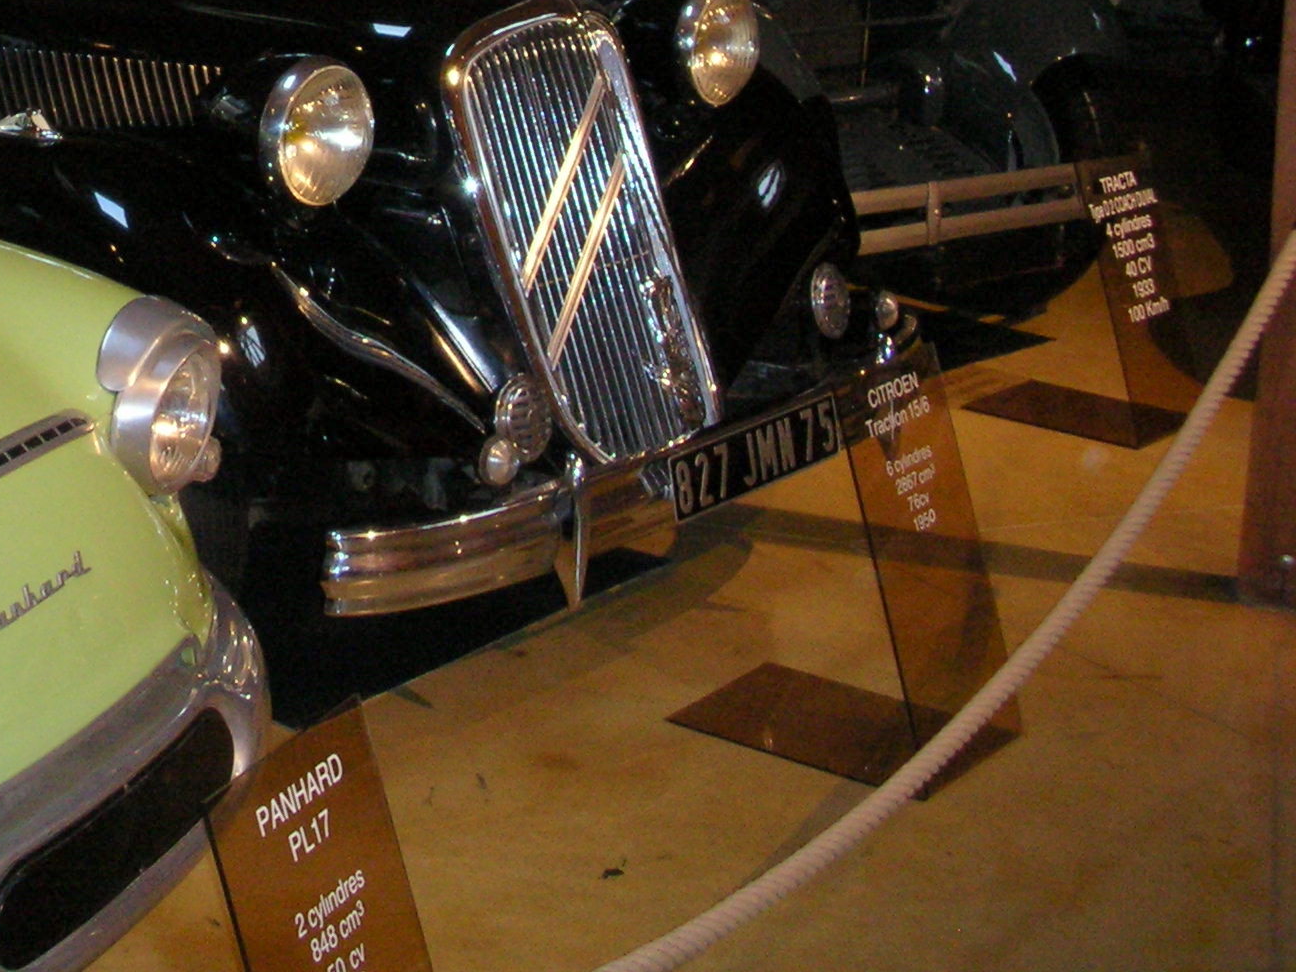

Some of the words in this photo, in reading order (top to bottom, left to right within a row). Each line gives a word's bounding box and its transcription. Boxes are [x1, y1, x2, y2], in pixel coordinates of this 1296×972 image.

[1099, 171, 1137, 194] TRACTA
[1106, 222, 1113, 238] 4
[1114, 214, 1153, 239] cylindres
[1112, 238, 1135, 259] 1500
[1125, 260, 1138, 278] 40
[1138, 255, 1153, 272] CV
[1132, 278, 1156, 299] 1933
[1128, 303, 1145, 323] 100
[1144, 296, 1170, 318] Km/h
[867, 371, 920, 408] CITROEN
[865, 408, 908, 438] Traction
[907, 395, 931, 420] 15/6
[675, 442, 729, 515] 827
[743, 416, 798, 487] JMN
[799, 400, 836, 462] 75
[885, 460, 895, 477] 6
[893, 445, 933, 475] cylindres
[255, 752, 344, 838] PANHARD
[287, 807, 330, 863] PL17
[295, 912, 308, 939] 2
[307, 869, 366, 930] cylindres
[310, 924, 339, 963] 848
[349, 942, 366, 970] cv
